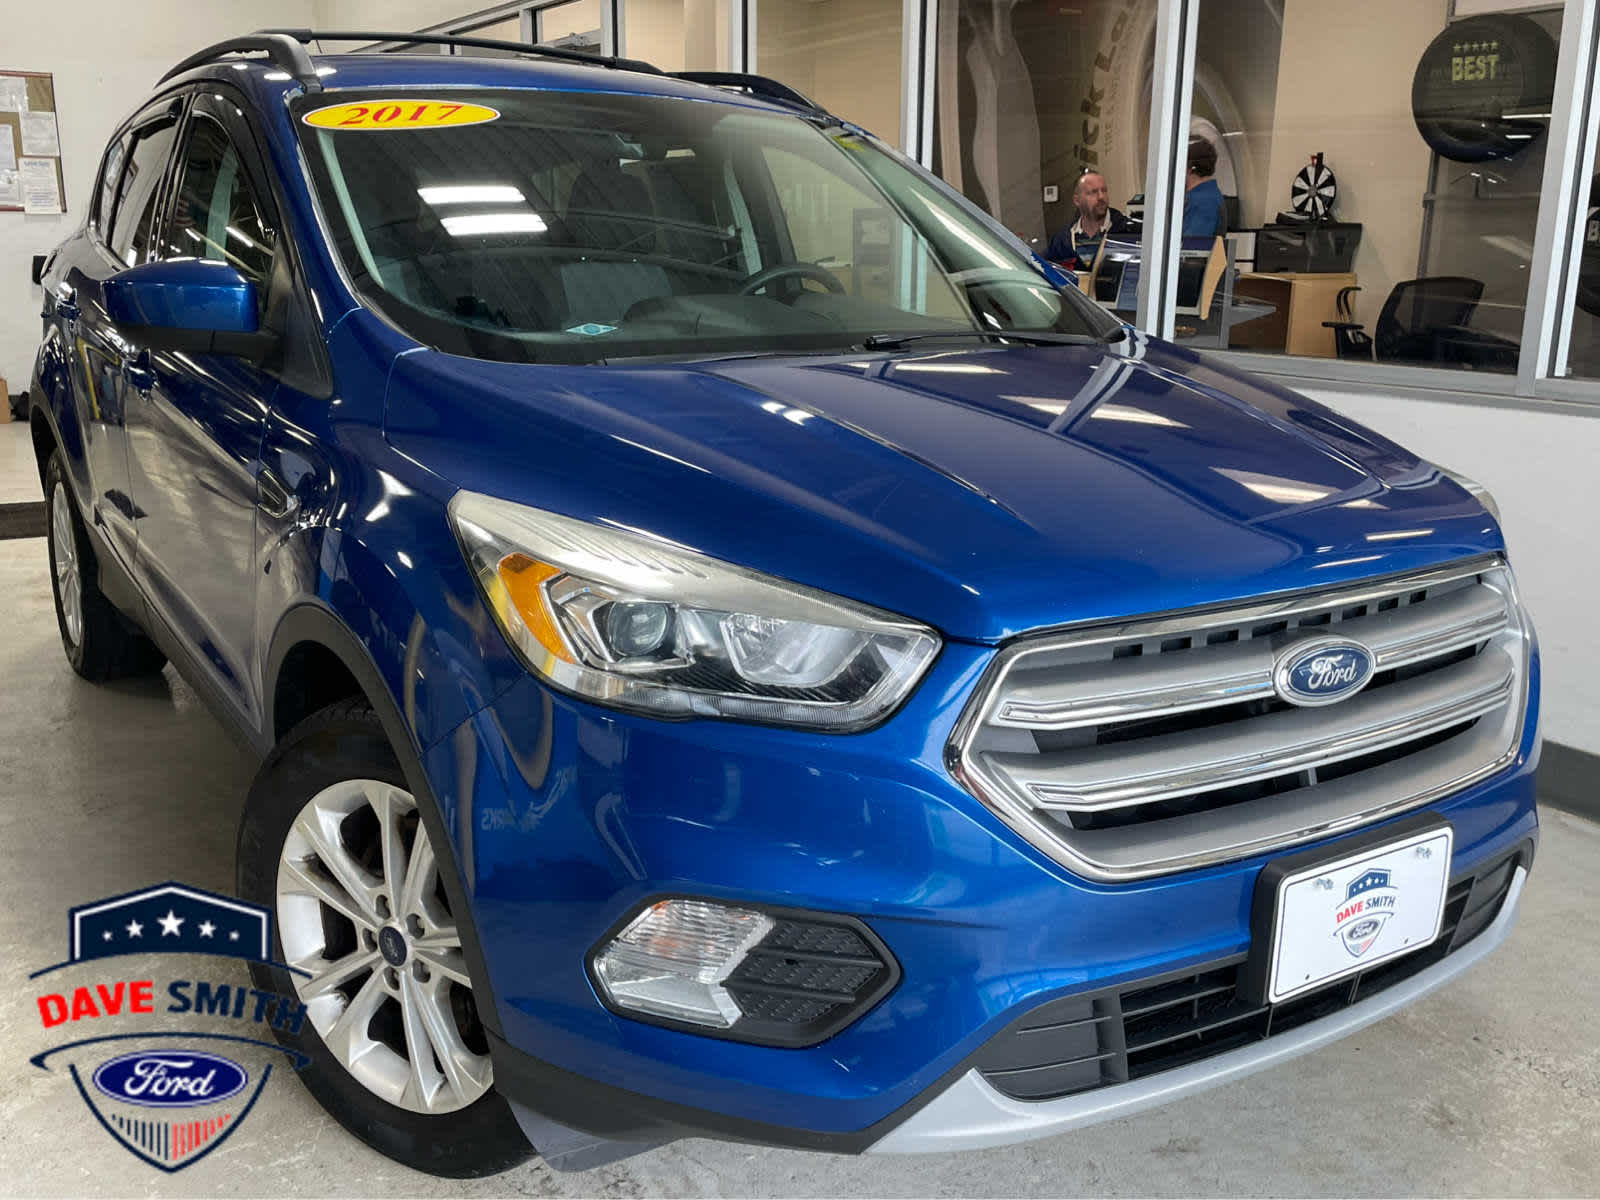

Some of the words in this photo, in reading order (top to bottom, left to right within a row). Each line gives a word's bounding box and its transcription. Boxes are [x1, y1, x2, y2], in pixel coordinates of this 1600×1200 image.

[1451, 54, 1500, 81] BEST
[338, 105, 464, 126] 2017
[1308, 654, 1357, 690] Ford
[1336, 901, 1364, 924] DAVE
[1364, 895, 1396, 910] SMITH
